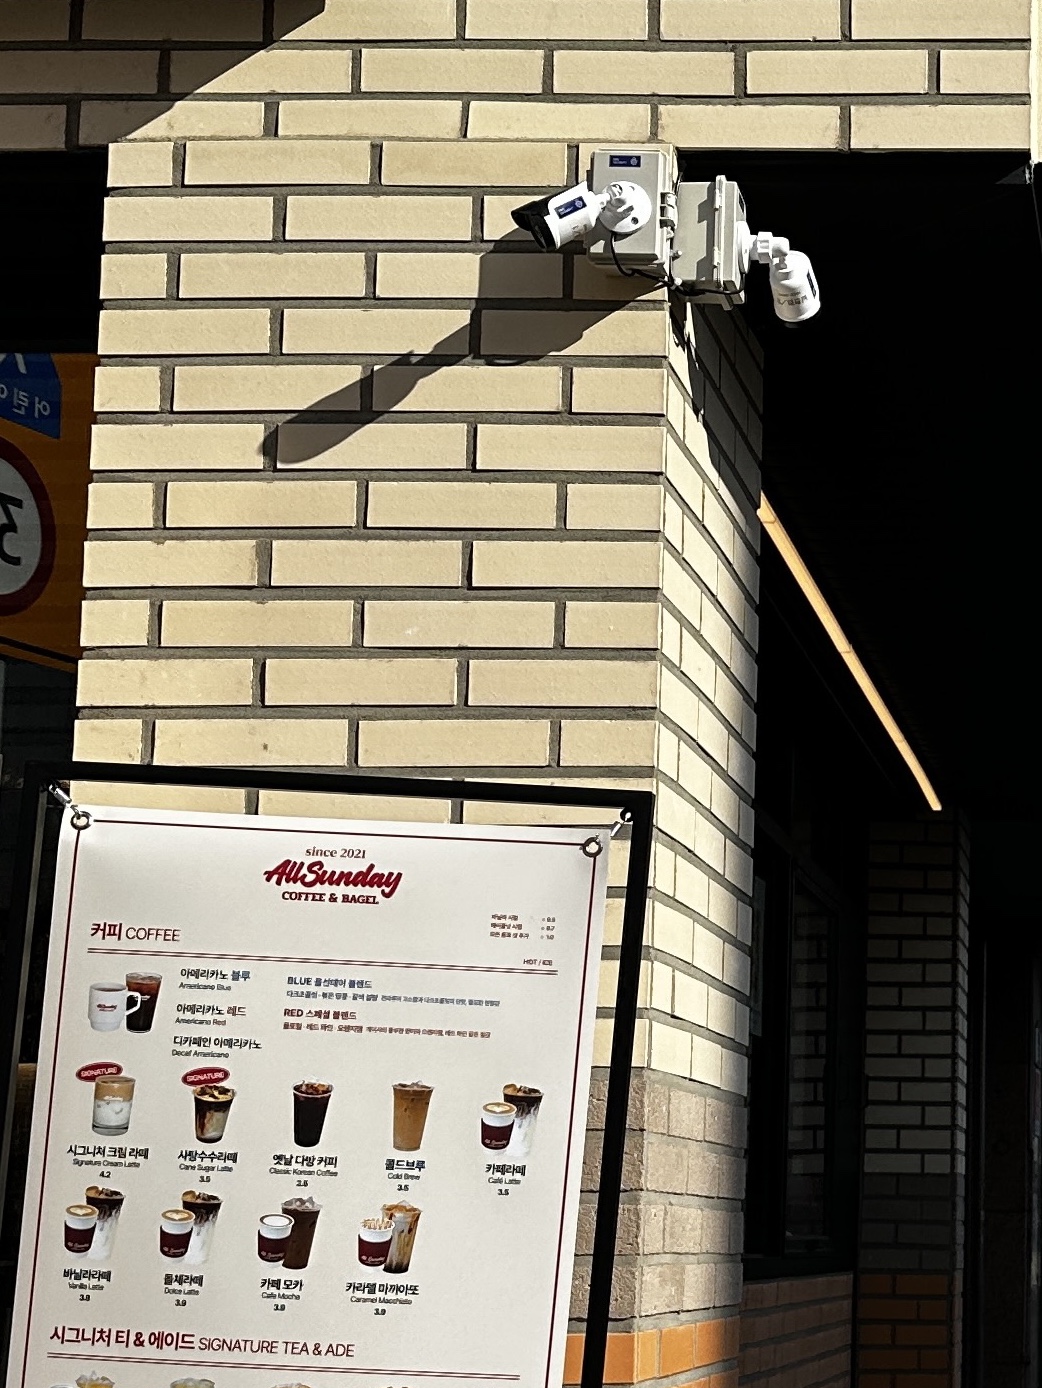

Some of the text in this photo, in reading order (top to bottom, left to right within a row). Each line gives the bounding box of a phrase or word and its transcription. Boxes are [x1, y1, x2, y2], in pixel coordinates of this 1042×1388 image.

[305, 847, 365, 858] since 2021
[263, 859, 403, 899] AllSunday
[282, 891, 379, 904] COFFEE & BAGEL
[91, 922, 180, 941] 커피 COFFEE
[181, 969, 250, 981] 아메리카노 블루
[287, 977, 312, 985] BLUE
[177, 1004, 246, 1016] 아메리카노 레드
[284, 1009, 303, 1017] RED
[174, 1036, 262, 1049] 디카페인 아메리카노
[193, 1050, 229, 1058] Americano
[67, 1145, 149, 1159] 시그니처 크림 라떼
[273, 1154, 337, 1168] 옛날 다방 커피
[385, 1159, 425, 1171] 콜드브루
[485, 1164, 526, 1176] 카페라떼
[63, 1269, 111, 1281] 바닐라라떼
[260, 1278, 304, 1291] 카페 모카
[50, 1326, 355, 1357] 시그니처 티 & 에이드 SIGNATURE TEA & ADE
